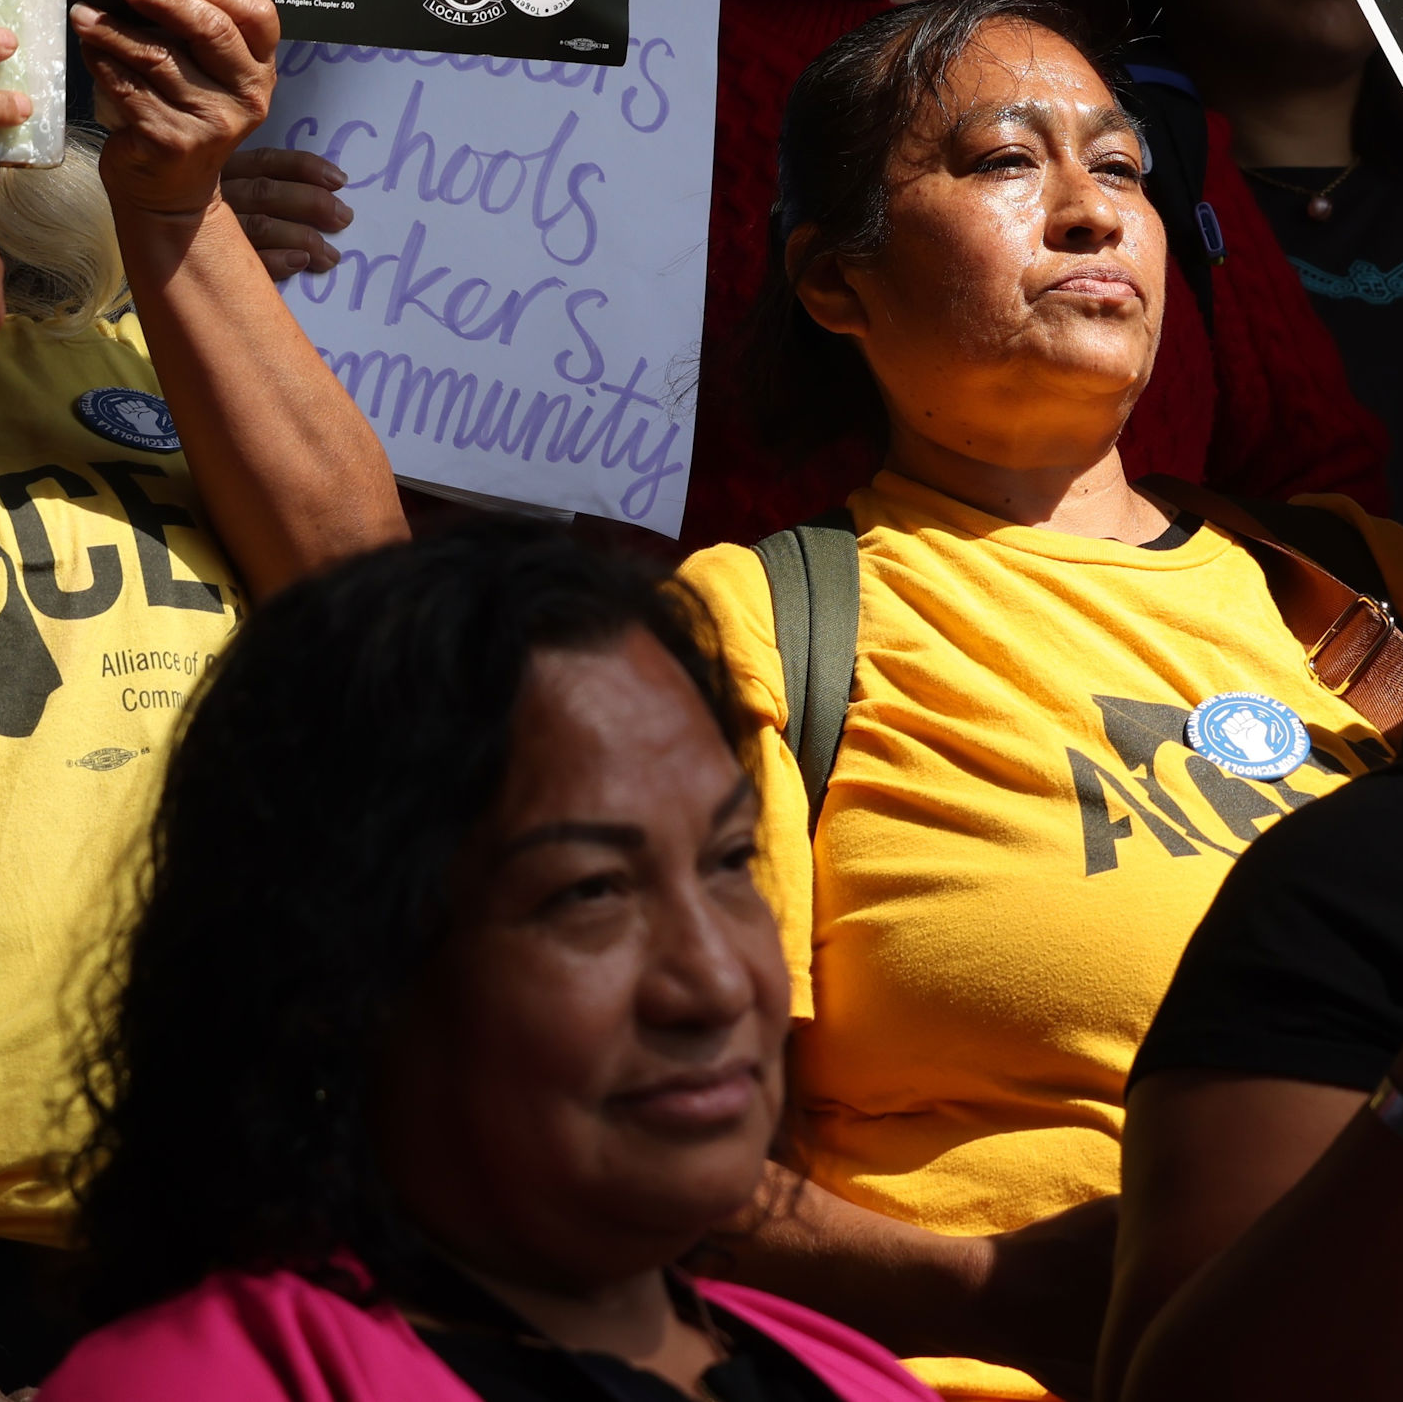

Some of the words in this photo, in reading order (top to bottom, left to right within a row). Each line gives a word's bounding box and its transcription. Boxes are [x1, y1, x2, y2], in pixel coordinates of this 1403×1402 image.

[341, 1, 355, 10] 500
[428, 0, 469, 24] LOCAL
[471, 6, 501, 24] 2010
[277, 219, 610, 386] orkers
[97, 419, 112, 431] LA
[112, 428, 164, 447] SCHOOLS
[315, 356, 684, 520] mmunity
[102, 648, 181, 678] Alliance
[184, 651, 199, 677] of
[1188, 706, 1204, 749] RECLAIM
[1200, 695, 1220, 710] OUR
[1219, 691, 1270, 704] SCHOOLS
[1270, 698, 1287, 713] LA
[1288, 717, 1307, 757] RECLAIM
[1206, 751, 1223, 767] LA
[1223, 762, 1275, 776] SCHOOLS
[1275, 755, 1298, 774] OUR
